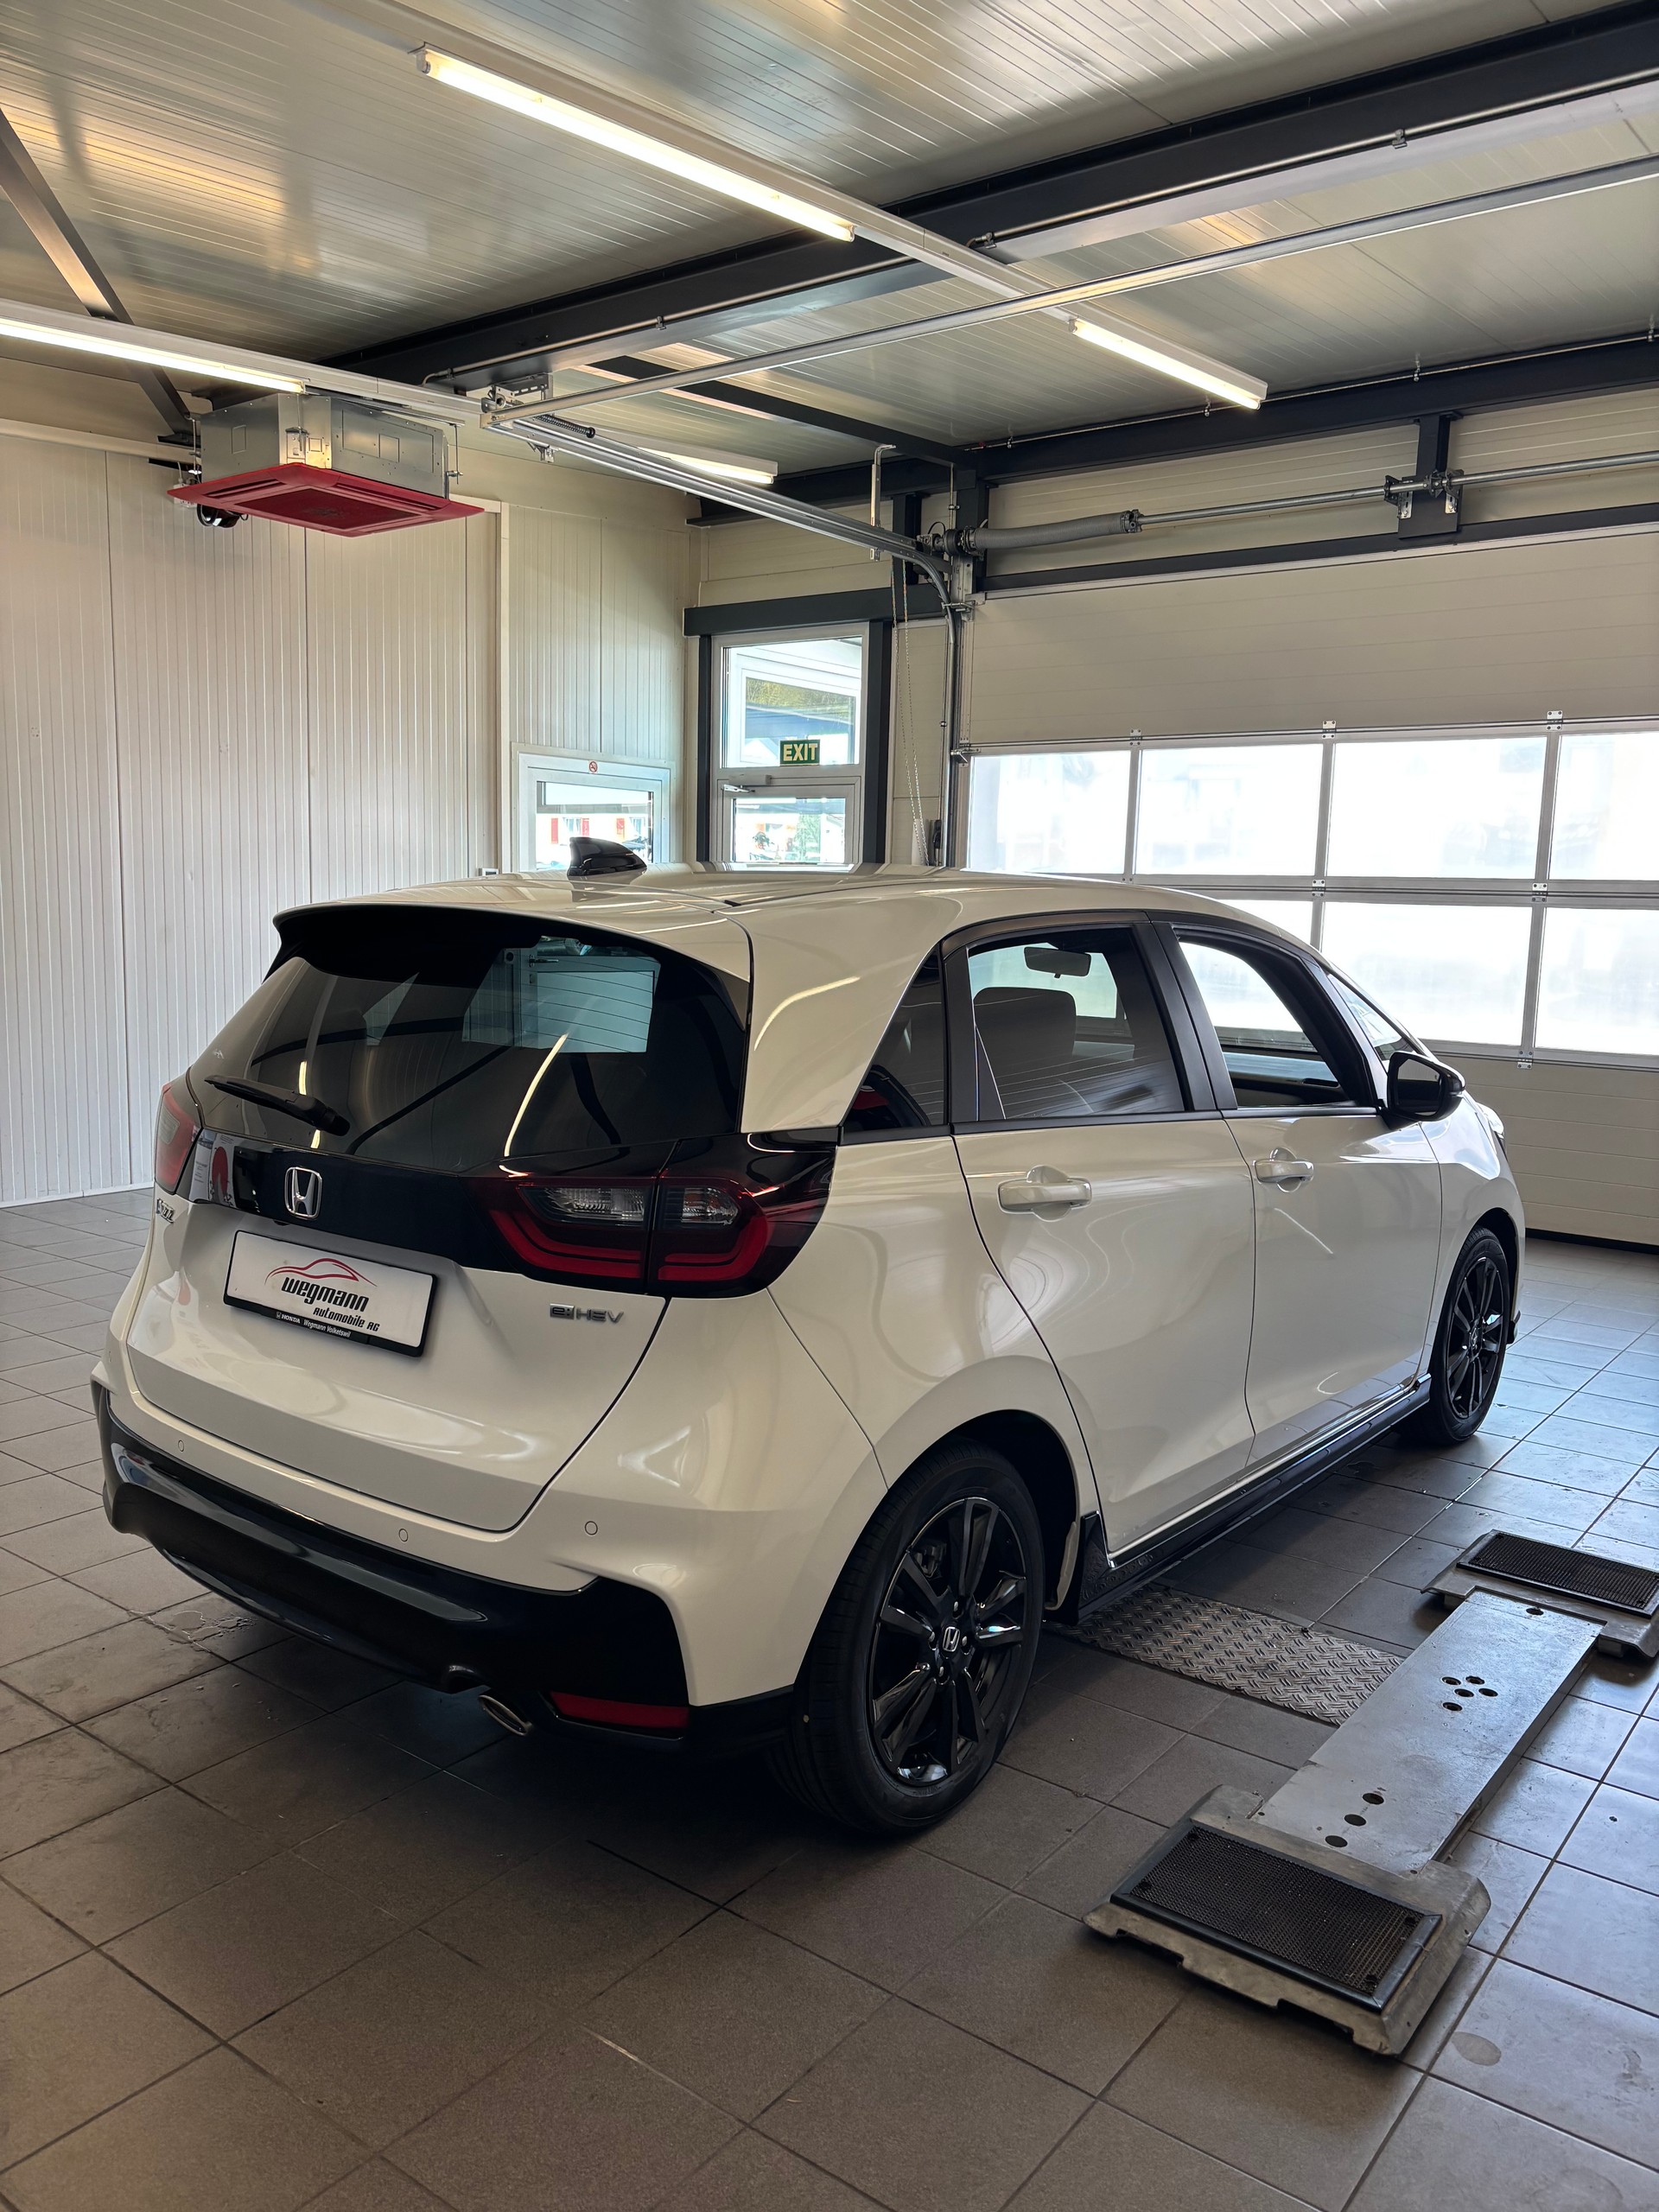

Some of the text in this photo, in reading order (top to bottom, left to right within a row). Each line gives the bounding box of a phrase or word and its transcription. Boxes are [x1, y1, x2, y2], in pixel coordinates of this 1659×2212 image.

[783, 743, 818, 761] EXIT
[281, 1277, 370, 1313] wegmann
[281, 1313, 301, 1324] HONDA
[303, 1319, 326, 1332] Wegmann
[366, 1320, 380, 1332] AG
